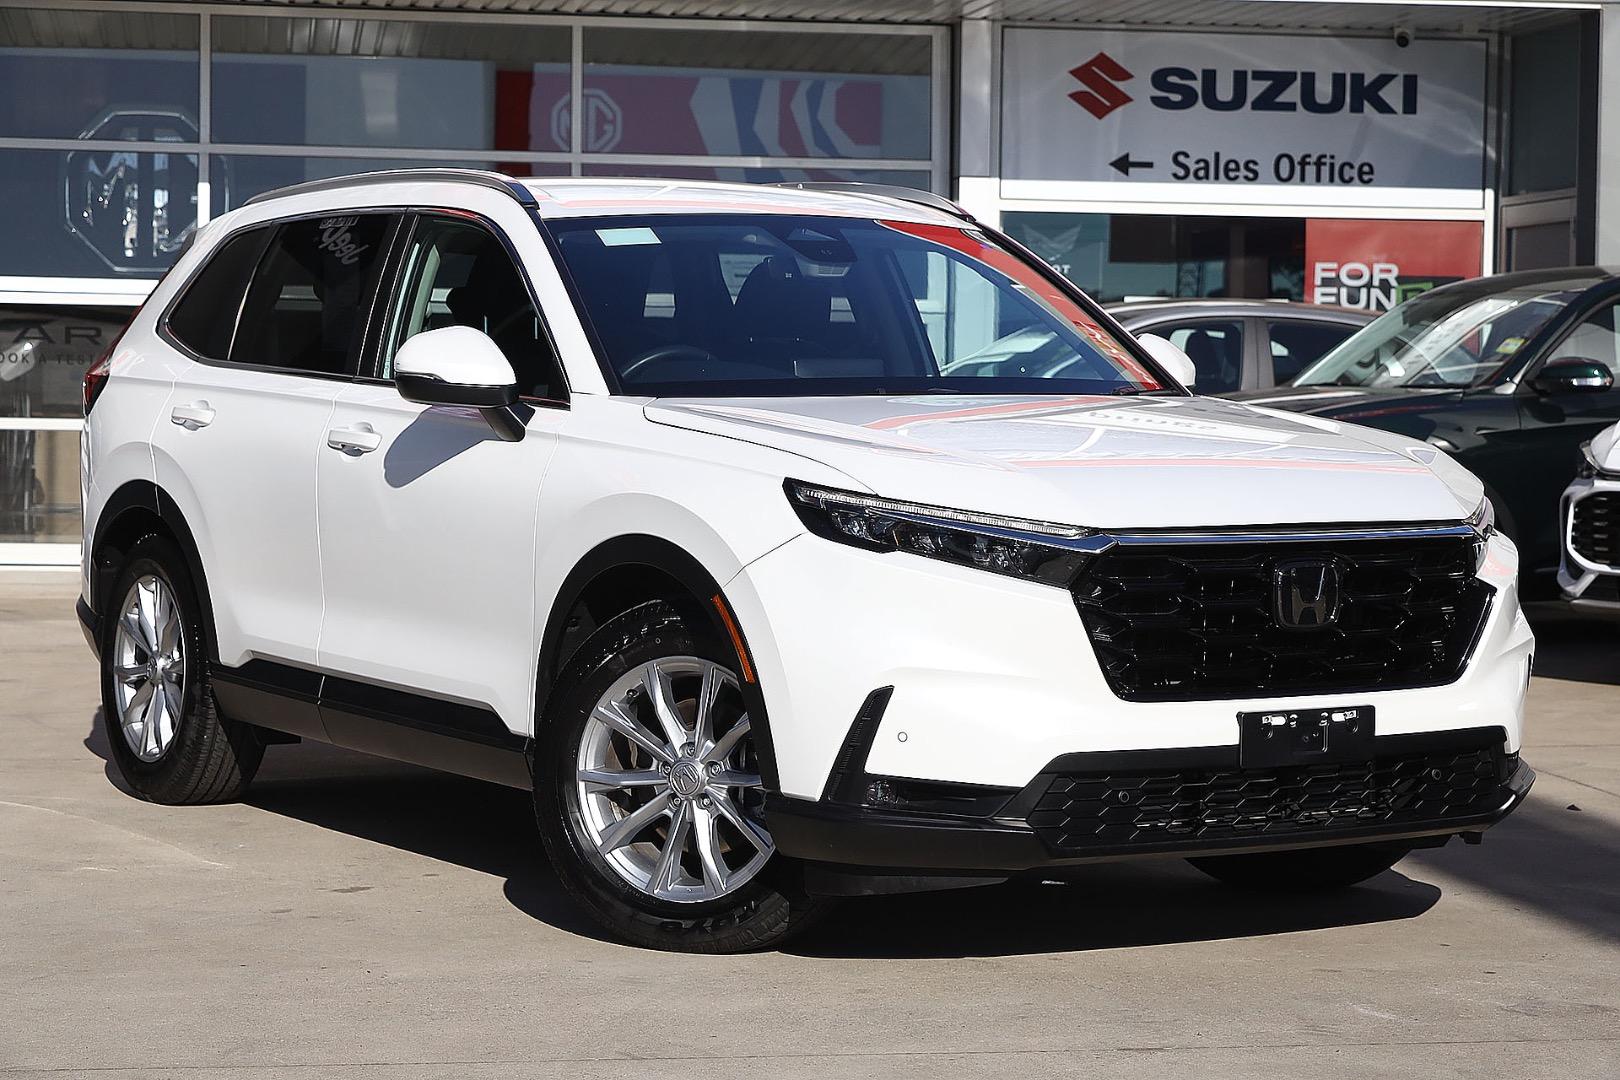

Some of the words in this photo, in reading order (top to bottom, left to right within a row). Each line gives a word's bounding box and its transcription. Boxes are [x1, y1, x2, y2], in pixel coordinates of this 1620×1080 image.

[1150, 67, 1418, 115] SUZUKI
[1171, 150, 1260, 182] Sales
[1273, 153, 1375, 185] Office
[1313, 262, 1399, 288] FOR
[1313, 286, 1396, 312] FUN
